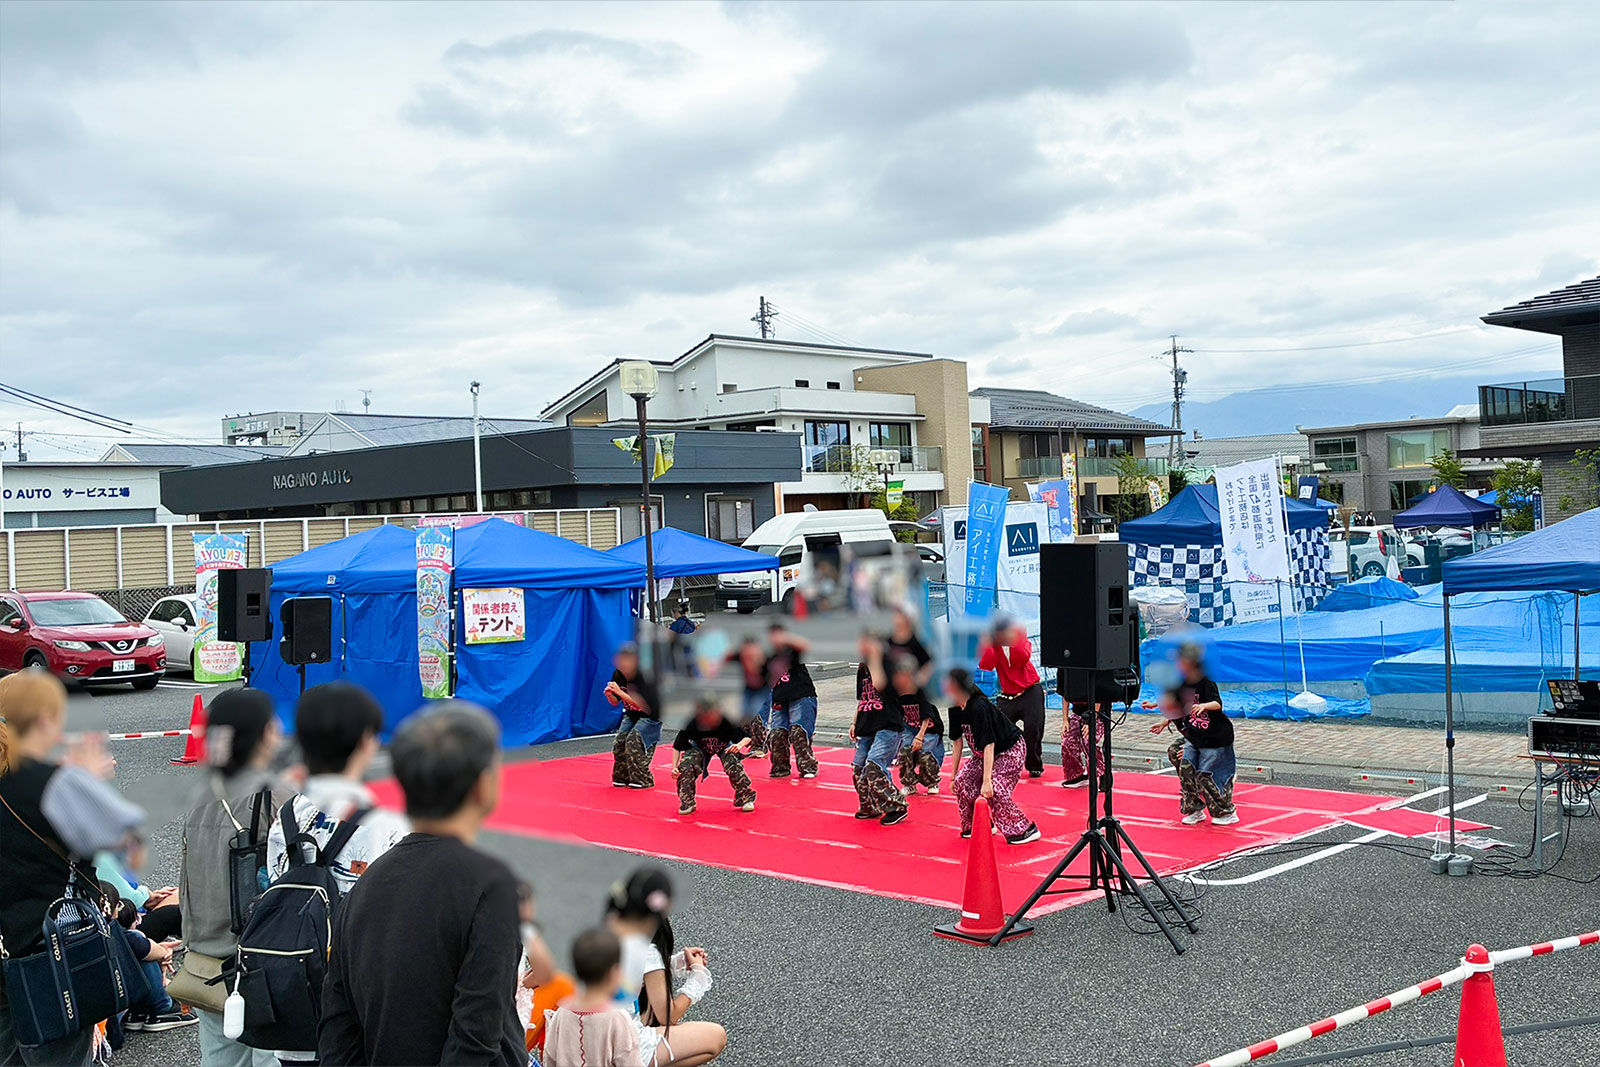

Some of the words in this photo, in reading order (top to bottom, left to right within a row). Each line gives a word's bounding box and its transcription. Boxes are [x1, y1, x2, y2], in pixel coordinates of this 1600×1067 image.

[273, 472, 317, 490] NAGANO
[16, 488, 52, 499] AUTO
[62, 487, 130, 499] サービス工場
[1012, 527, 1033, 546] AI
[966, 528, 983, 603] アイ工務店
[472, 602, 518, 616] 関係者控え
[479, 616, 513, 632] テント
[50, 933, 62, 961] COACH
[63, 990, 74, 1019] COACH
